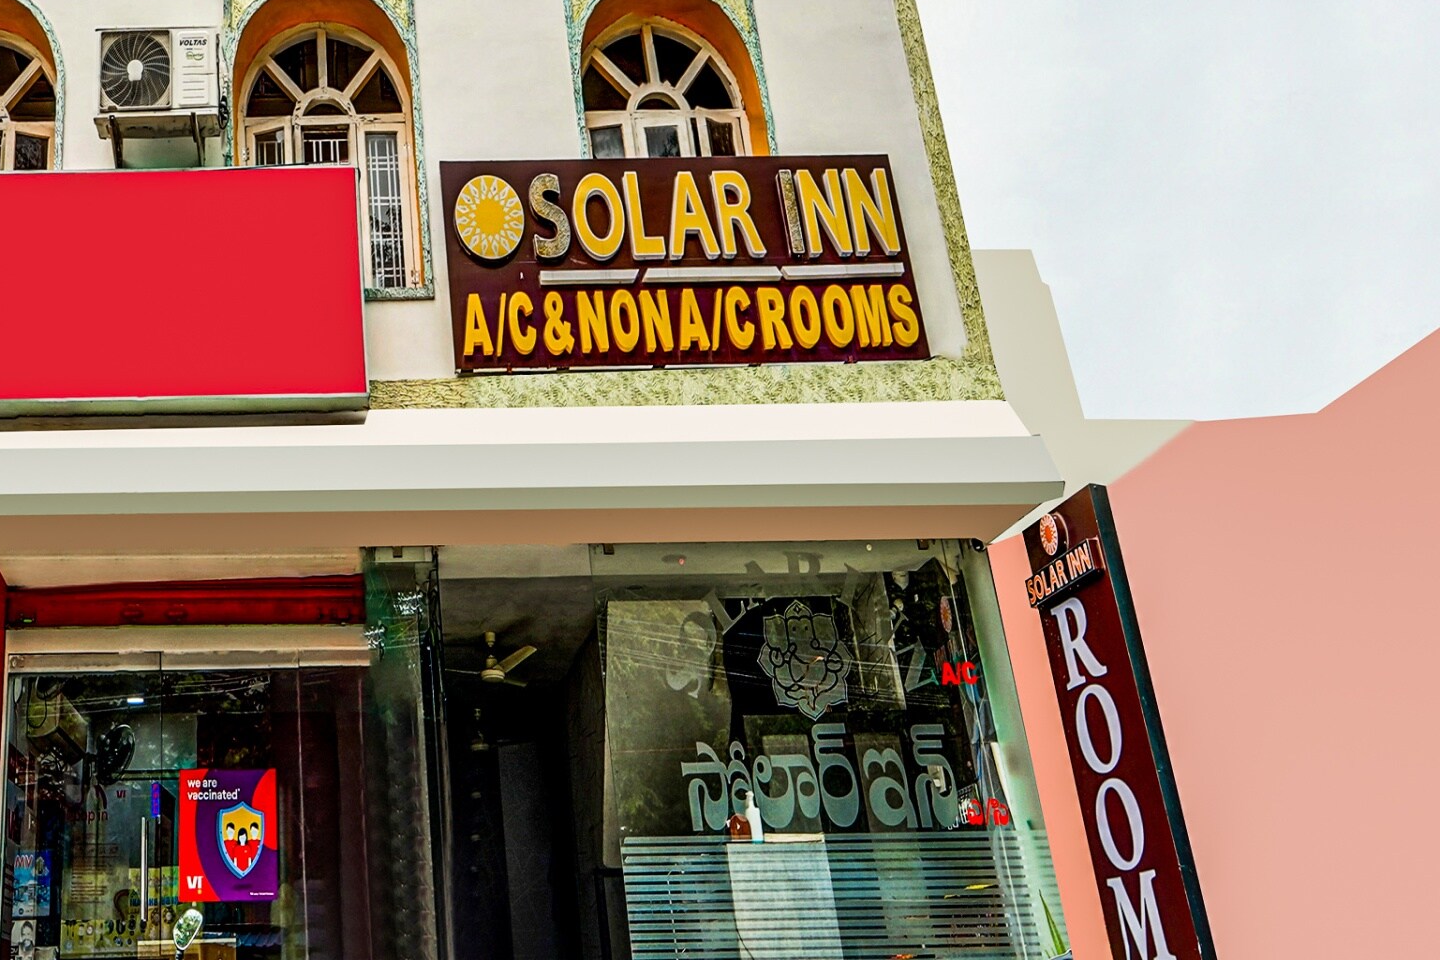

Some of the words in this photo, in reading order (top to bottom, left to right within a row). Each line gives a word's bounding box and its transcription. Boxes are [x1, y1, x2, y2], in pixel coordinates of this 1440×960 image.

[528, 169, 767, 261] SOLAR
[776, 167, 903, 258] INN
[1027, 559, 1069, 605] SOLAR
[1065, 542, 1093, 581] INN
[941, 660, 978, 686] A/C
[187, 779, 201, 788] we
[202, 779, 218, 788] are
[680, 723, 860, 833] సోలార్
[863, 723, 958, 828] ఇన్
